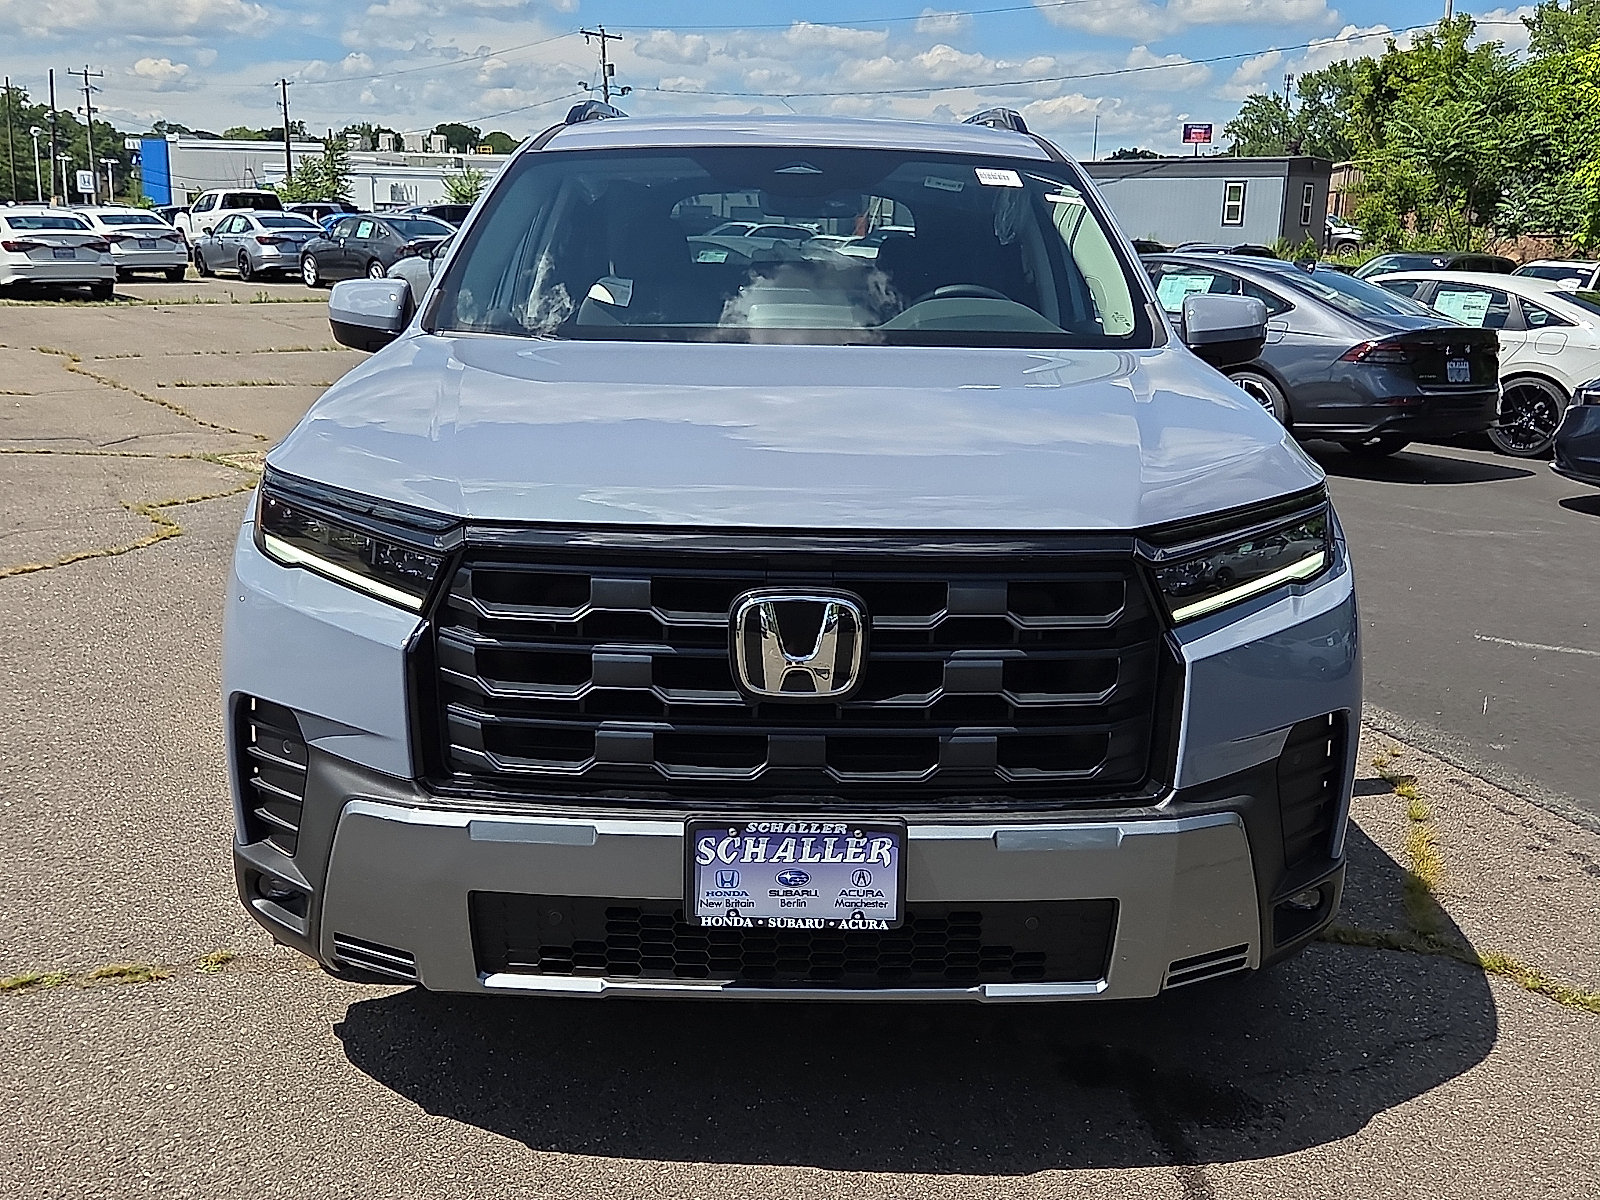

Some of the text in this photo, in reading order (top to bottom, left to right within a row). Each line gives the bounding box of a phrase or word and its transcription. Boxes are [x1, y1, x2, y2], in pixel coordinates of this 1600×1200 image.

[746, 822, 848, 834] SCHALLER
[695, 836, 894, 867] SCHALLER
[768, 889, 819, 897] SUBARU
[838, 889, 885, 897] ACURA
[699, 899, 755, 908] New Britain
[780, 898, 807, 908] Berlin
[834, 898, 889, 908] Manchester
[700, 916, 889, 930] HONDA SUBARU ACURA
